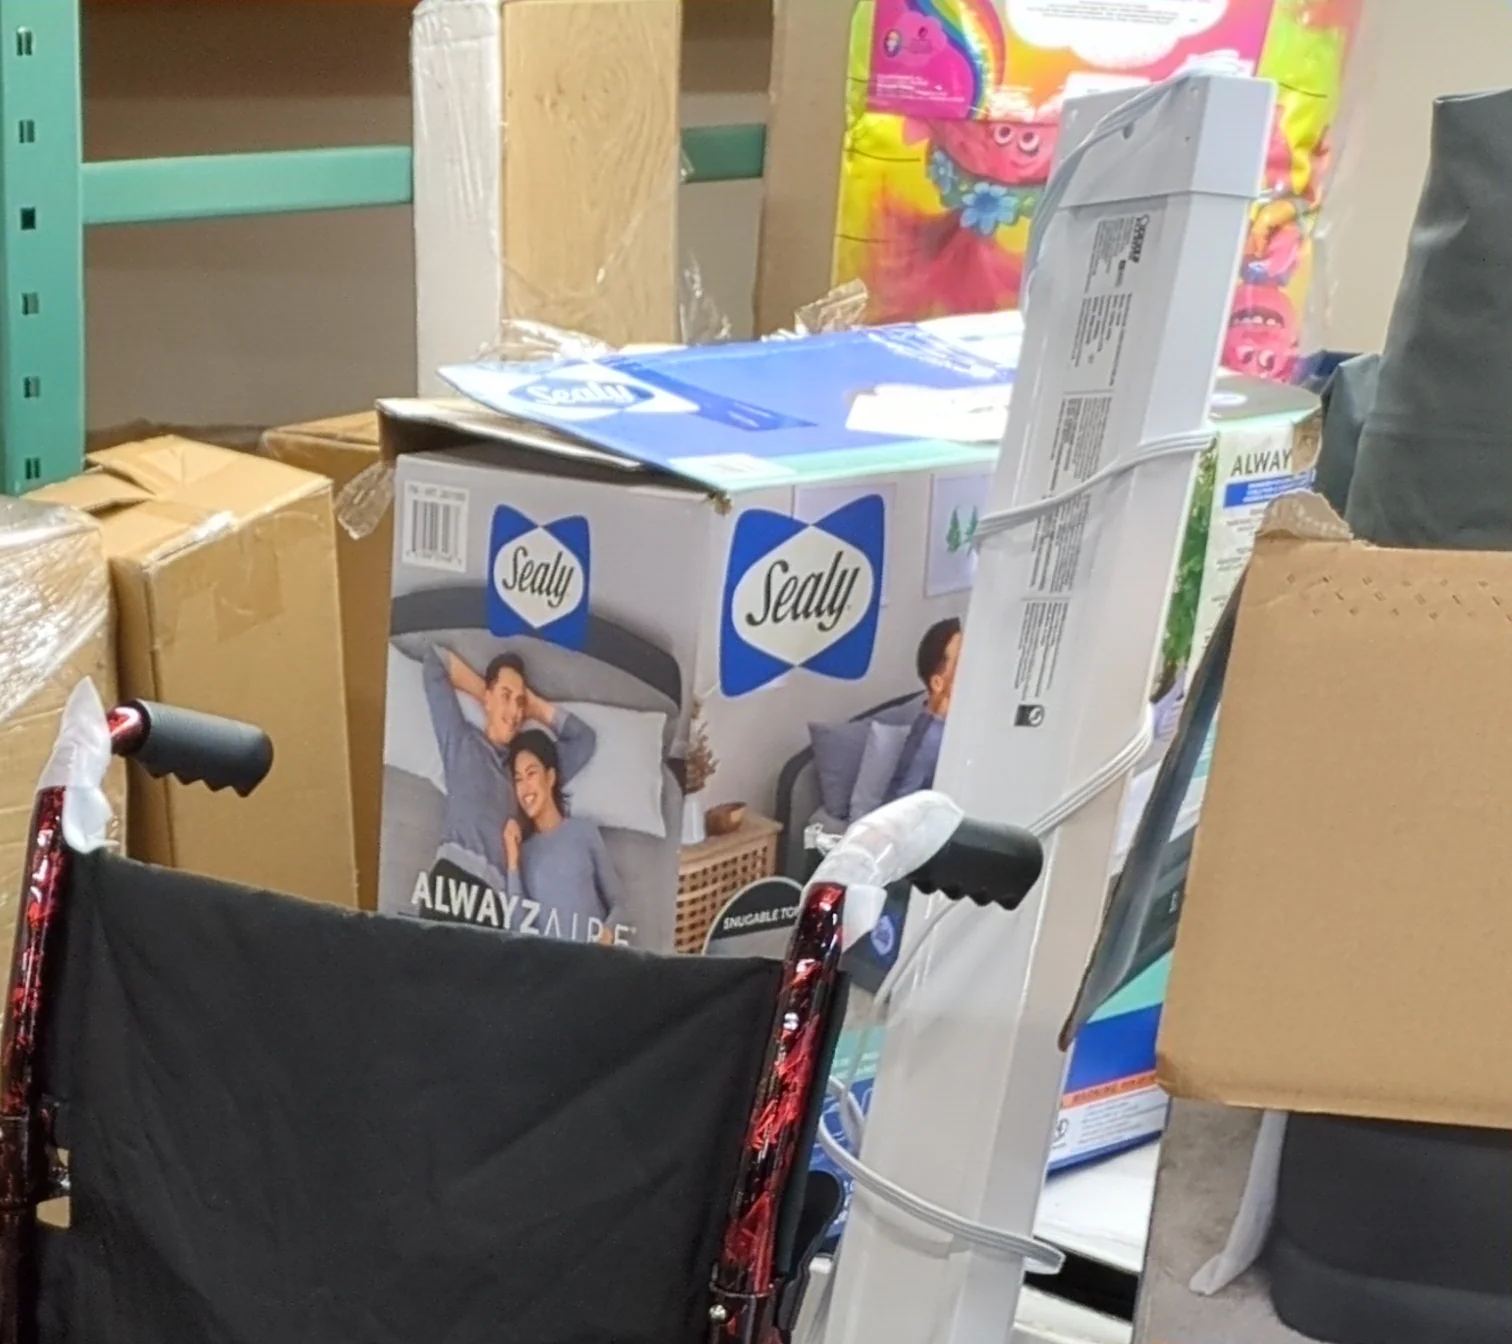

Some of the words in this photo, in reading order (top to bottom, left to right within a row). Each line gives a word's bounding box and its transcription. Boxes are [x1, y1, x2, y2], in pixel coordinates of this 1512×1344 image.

[501, 544, 576, 609] Sealy
[745, 550, 862, 633] Sealy
[722, 907, 778, 931] SNUGABLE
